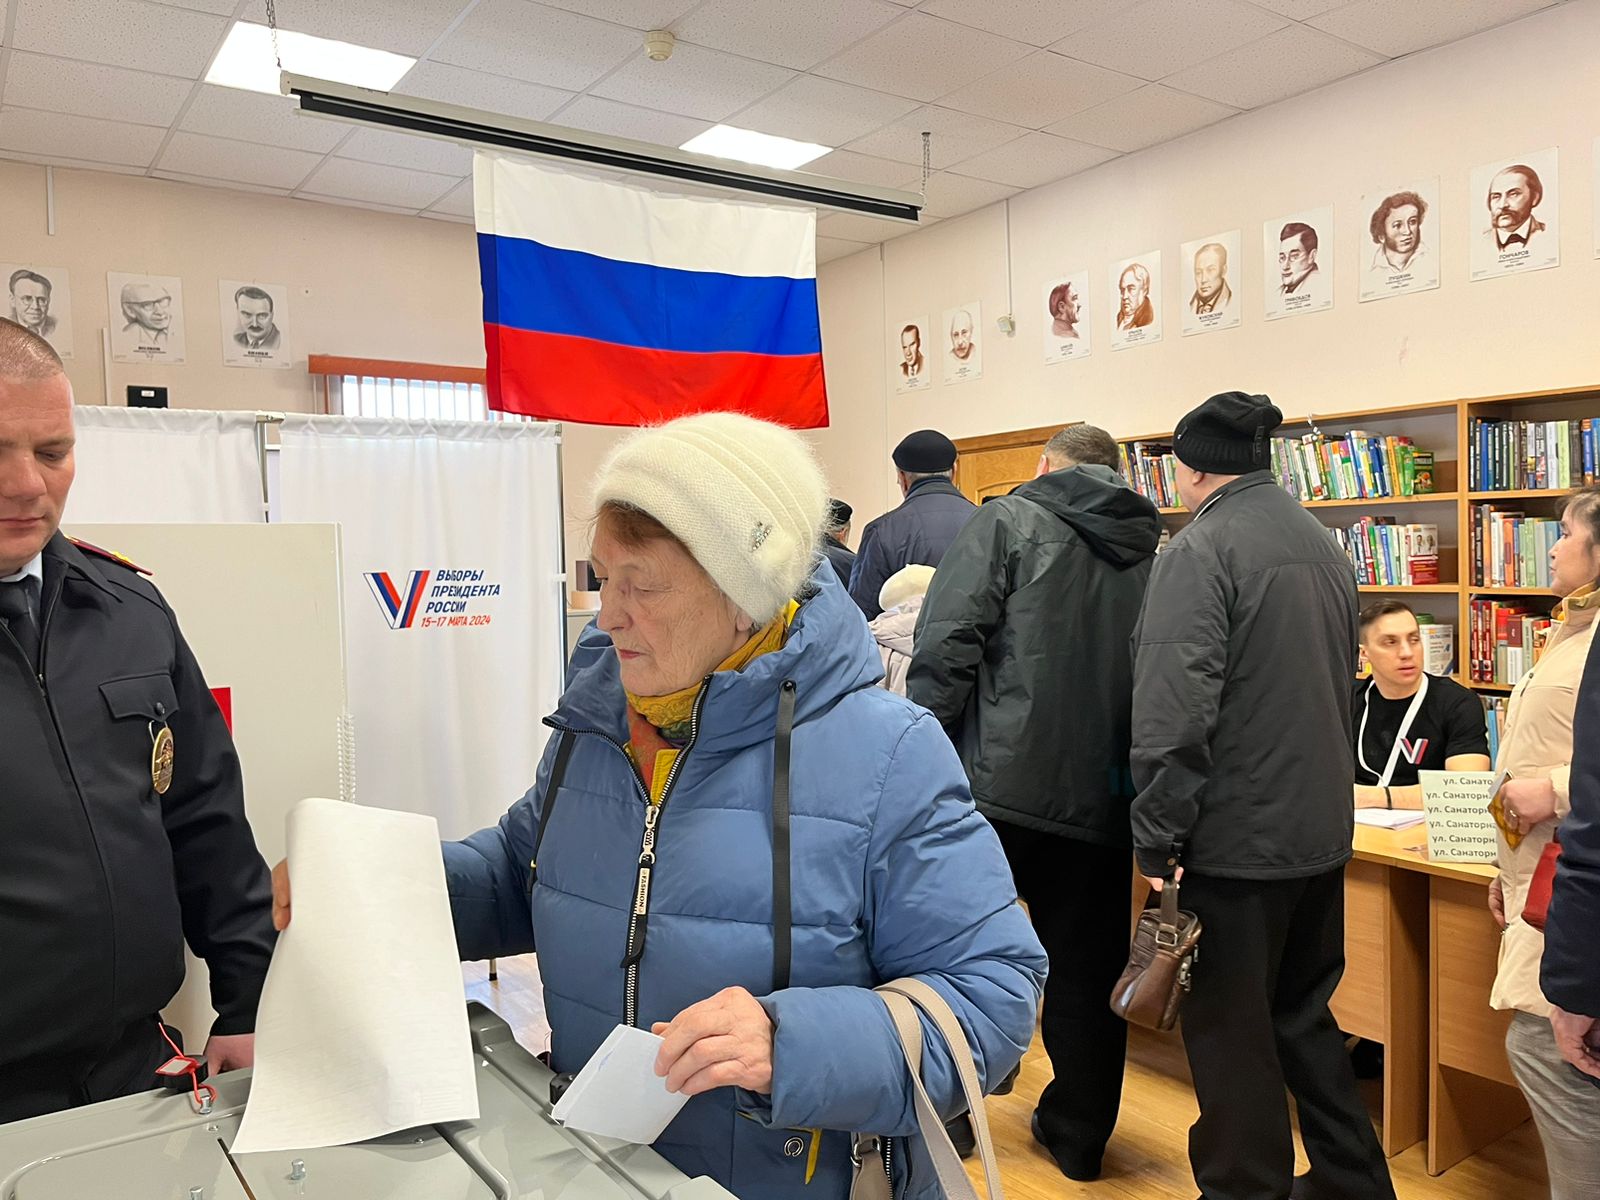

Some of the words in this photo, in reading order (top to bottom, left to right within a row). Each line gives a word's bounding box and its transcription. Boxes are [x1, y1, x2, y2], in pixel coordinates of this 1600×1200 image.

[436, 569, 484, 582] ВЫБОРЫ
[431, 584, 501, 598] ПРЕЗИДЕНТА
[425, 601, 467, 614] РОССИИ
[447, 616, 468, 627] МАРТА
[468, 615, 491, 626] 2024
[1443, 778, 1457, 786] ул.
[1459, 777, 1494, 785] Санато
[1426, 792, 1440, 800] ул.
[1443, 791, 1492, 801] Санаторн
[1428, 806, 1442, 814] ул.
[1432, 835, 1447, 843] ул.
[1449, 835, 1497, 844] Санаторн
[1434, 849, 1448, 857] ул.
[1450, 848, 1497, 858] Санаторн
[638, 875, 647, 907] FASHION
